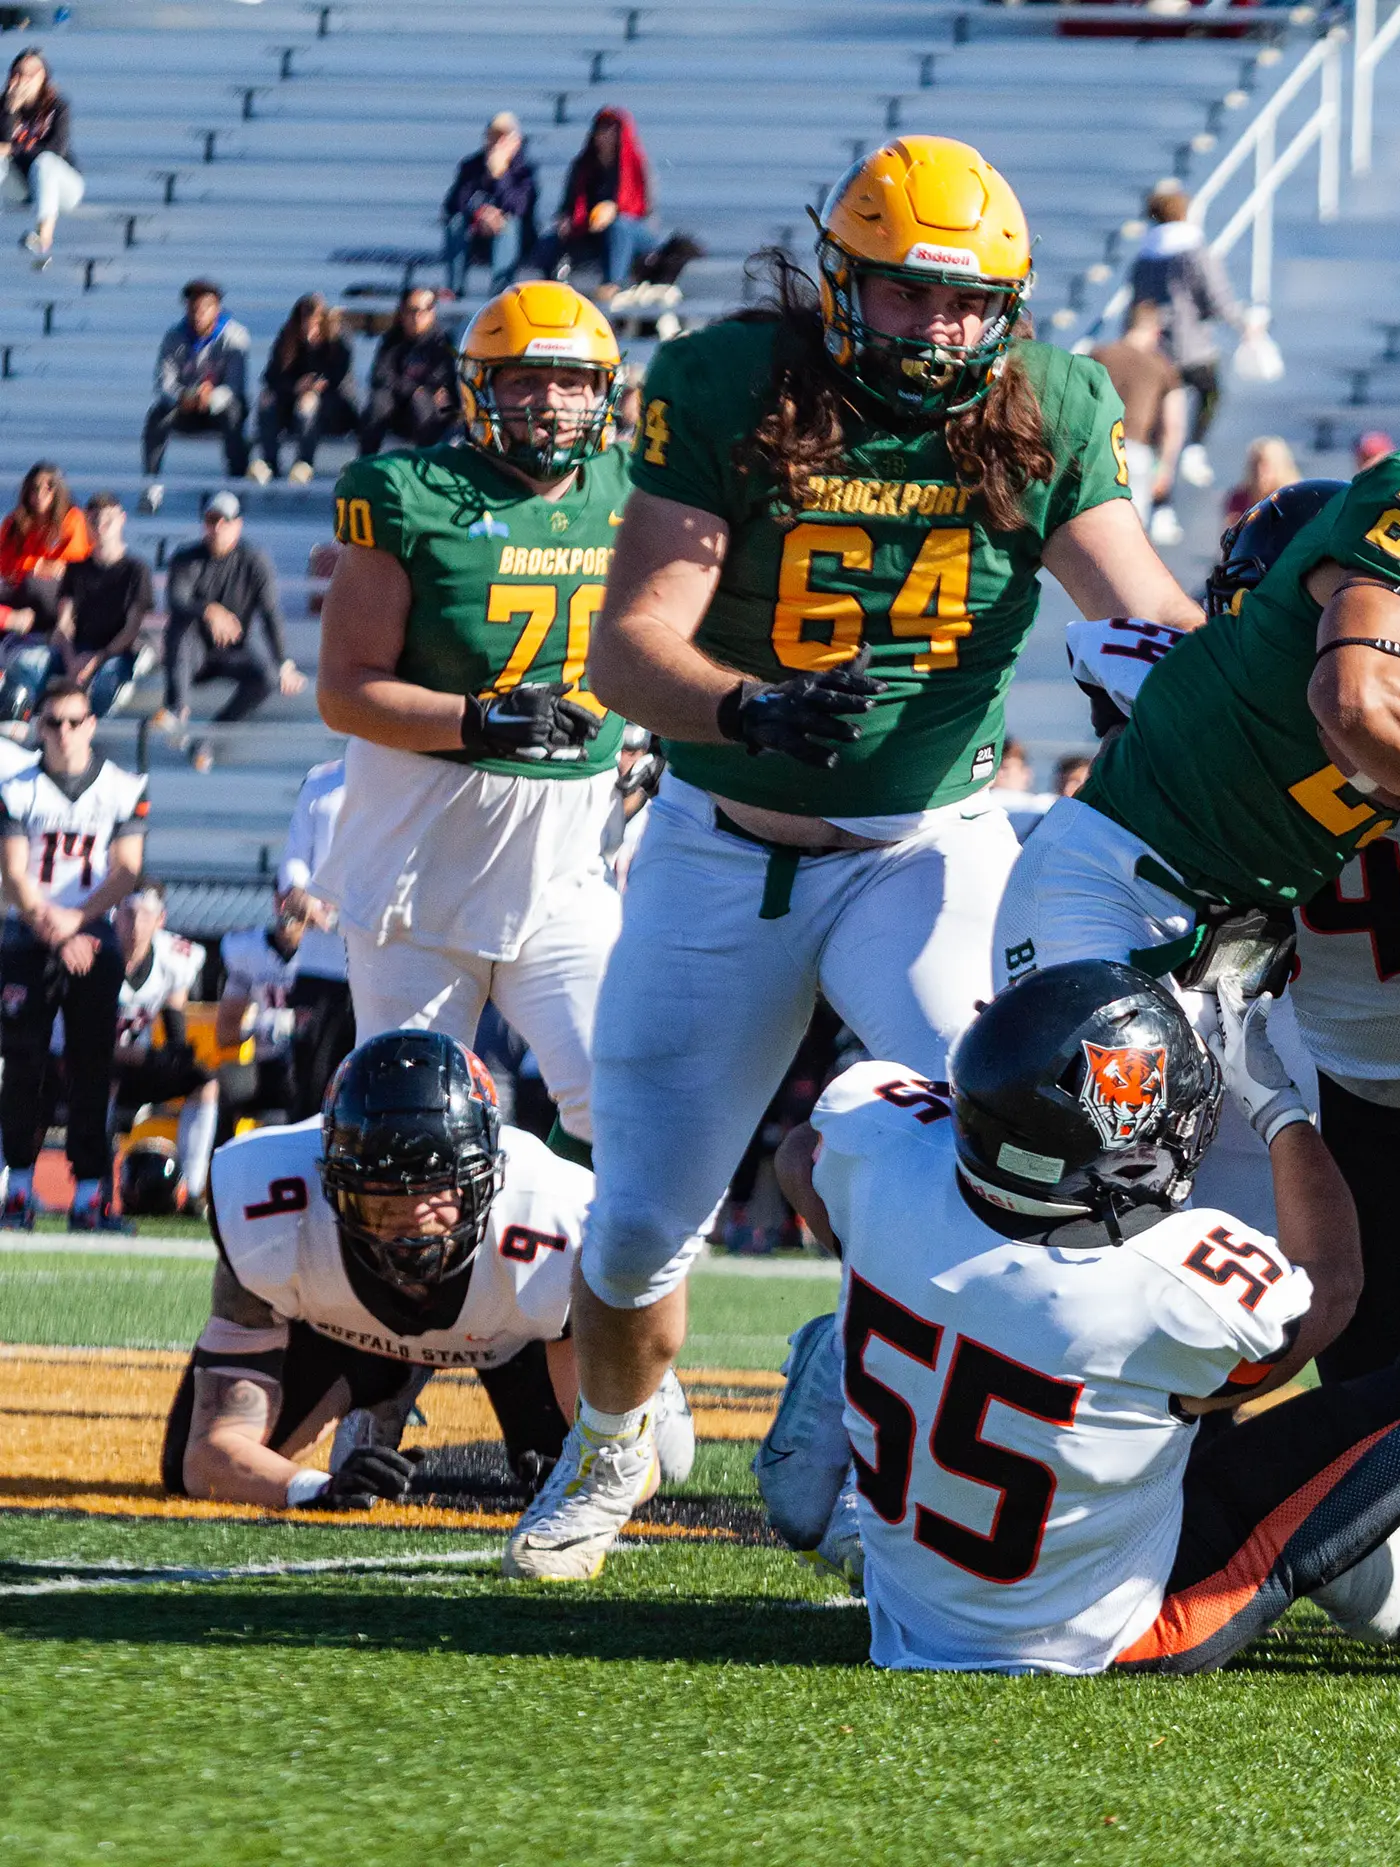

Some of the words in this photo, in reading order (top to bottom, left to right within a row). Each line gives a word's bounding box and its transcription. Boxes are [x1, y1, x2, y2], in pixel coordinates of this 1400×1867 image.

[916, 247, 971, 267] Riddell
[802, 474, 974, 517] BROCKPORT
[769, 521, 976, 674] 64
[975, 746, 995, 763] 2XL
[39, 831, 97, 888] 14
[243, 1176, 309, 1221] 9
[499, 1223, 569, 1264] 9
[1181, 1225, 1284, 1312] 55
[421, 1347, 498, 1364] STATE
[843, 1265, 1086, 1586] 55
